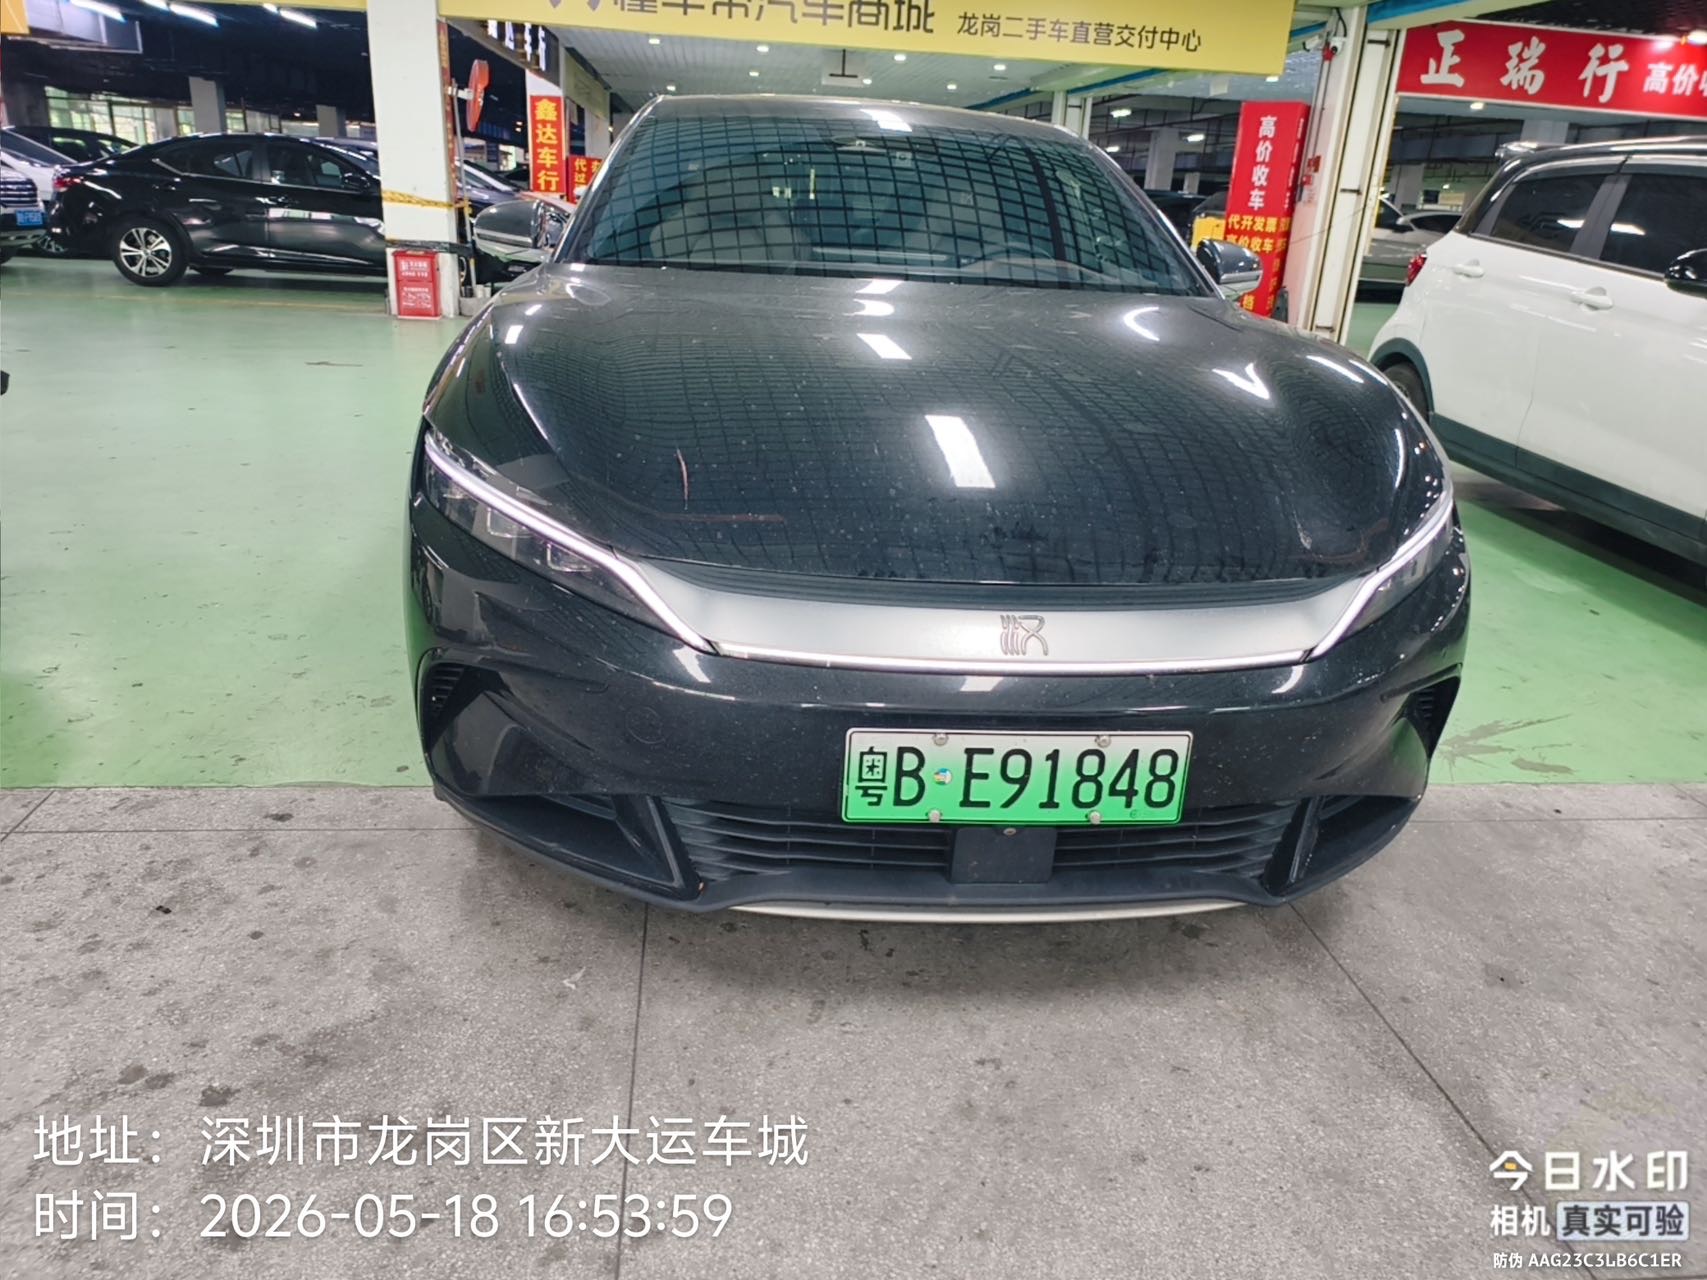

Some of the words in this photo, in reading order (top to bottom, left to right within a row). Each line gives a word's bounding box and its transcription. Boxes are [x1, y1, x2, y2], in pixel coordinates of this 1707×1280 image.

[957, 12, 1202, 53] 龙岗二手车直营交付中心
[1420, 29, 1629, 103] 正瑞行
[535, 98, 559, 191] 鑫达车行
[1248, 115, 1278, 211] 高价收车
[1228, 214, 1278, 233] 代开发票
